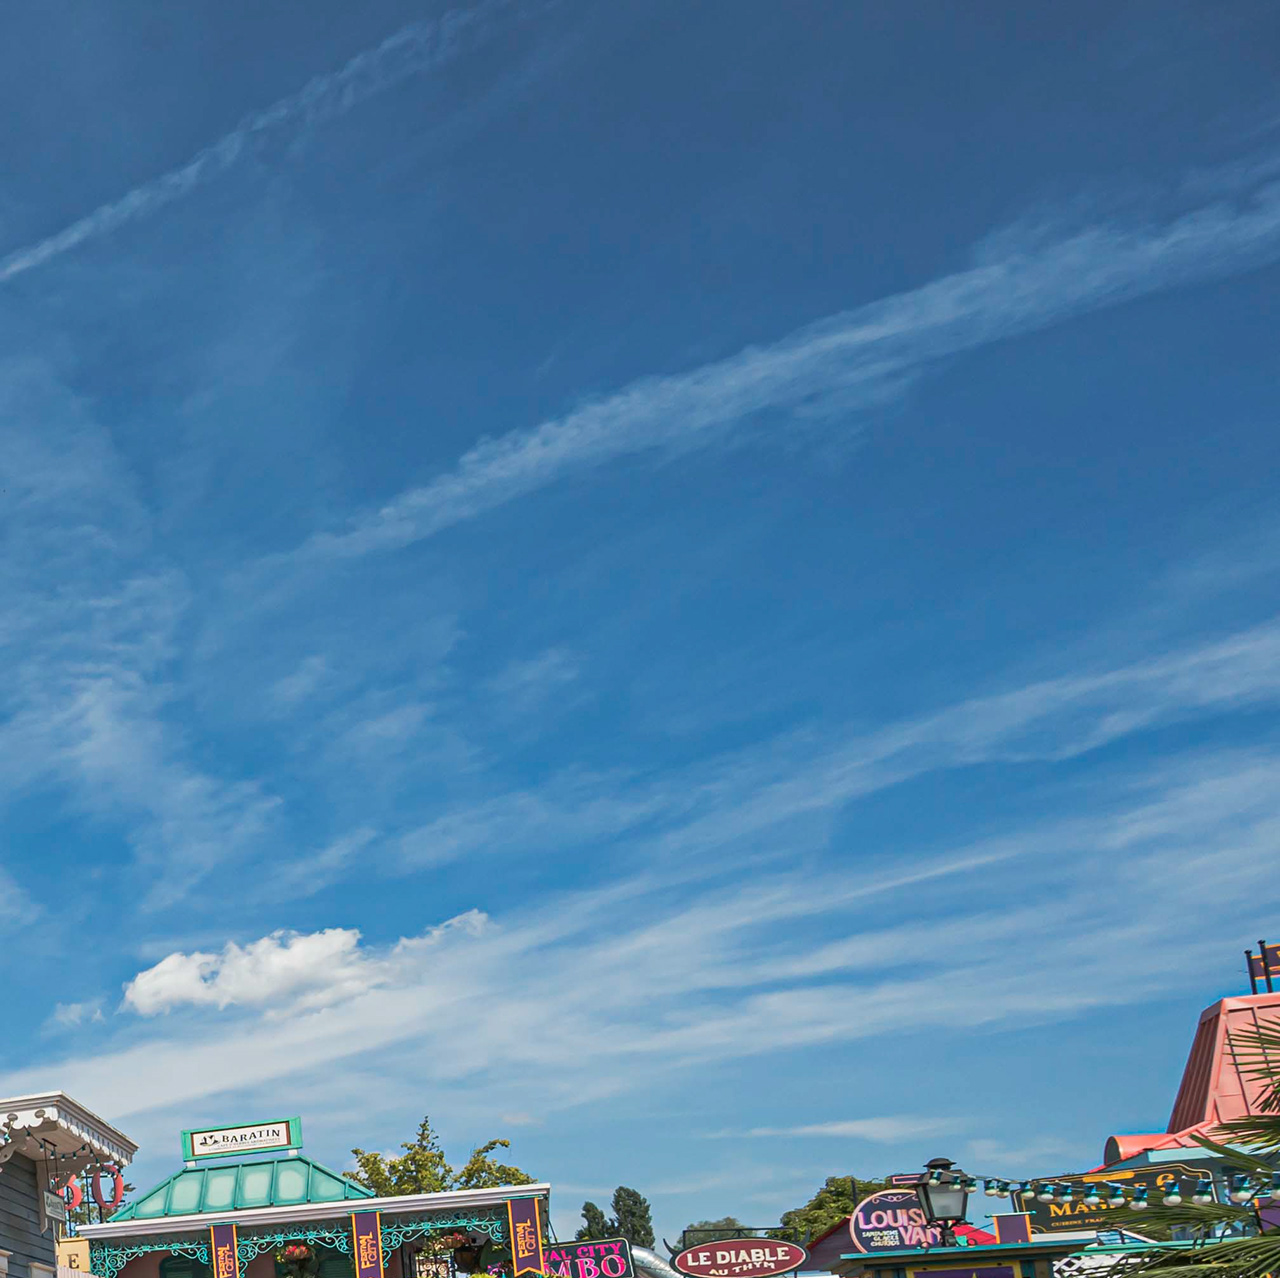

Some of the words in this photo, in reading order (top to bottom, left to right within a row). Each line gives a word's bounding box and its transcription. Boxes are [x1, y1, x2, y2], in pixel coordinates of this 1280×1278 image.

[222, 1129, 280, 1143] BARATIN
[857, 1207, 927, 1230] LOUIS
[516, 1218, 534, 1258] FESTIVAL
[525, 1226, 536, 1250] CITY
[217, 1243, 232, 1278] FESTIVAL
[225, 1250, 234, 1271] CITY
[359, 1231, 375, 1269] FESTIVAL
[366, 1238, 377, 1262] CITY
[543, 1248, 572, 1262] VAL
[576, 1242, 623, 1258] CITY
[687, 1252, 712, 1266] LE
[716, 1246, 790, 1264] DIABLE
[709, 1268, 728, 1276] AU
[732, 1261, 776, 1273] THYM
